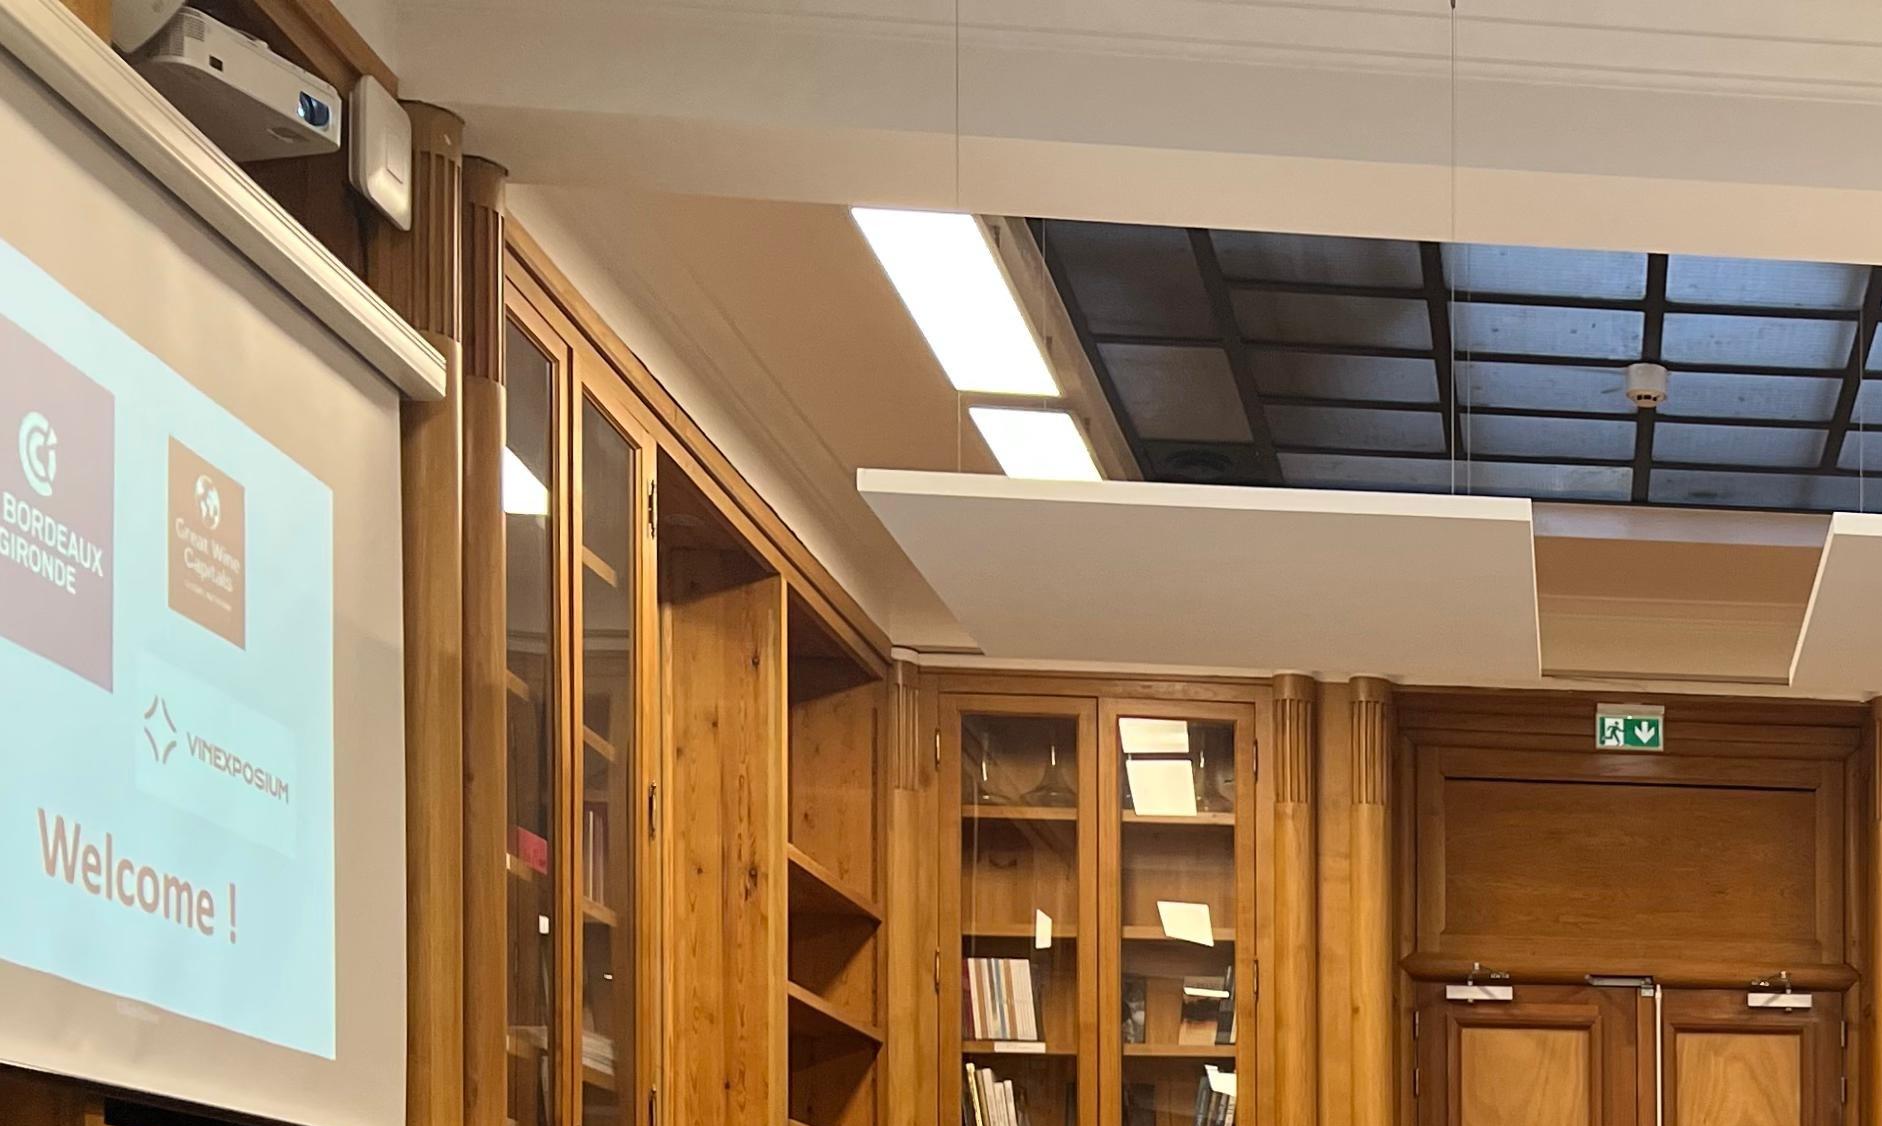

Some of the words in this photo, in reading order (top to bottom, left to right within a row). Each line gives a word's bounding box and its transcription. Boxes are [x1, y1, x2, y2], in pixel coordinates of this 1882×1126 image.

[0, 526, 76, 595] GIRONDE
[3, 491, 103, 577] BORDEAUX
[187, 731, 289, 804] VINEXPOSIUM
[37, 807, 215, 936] Welcome
